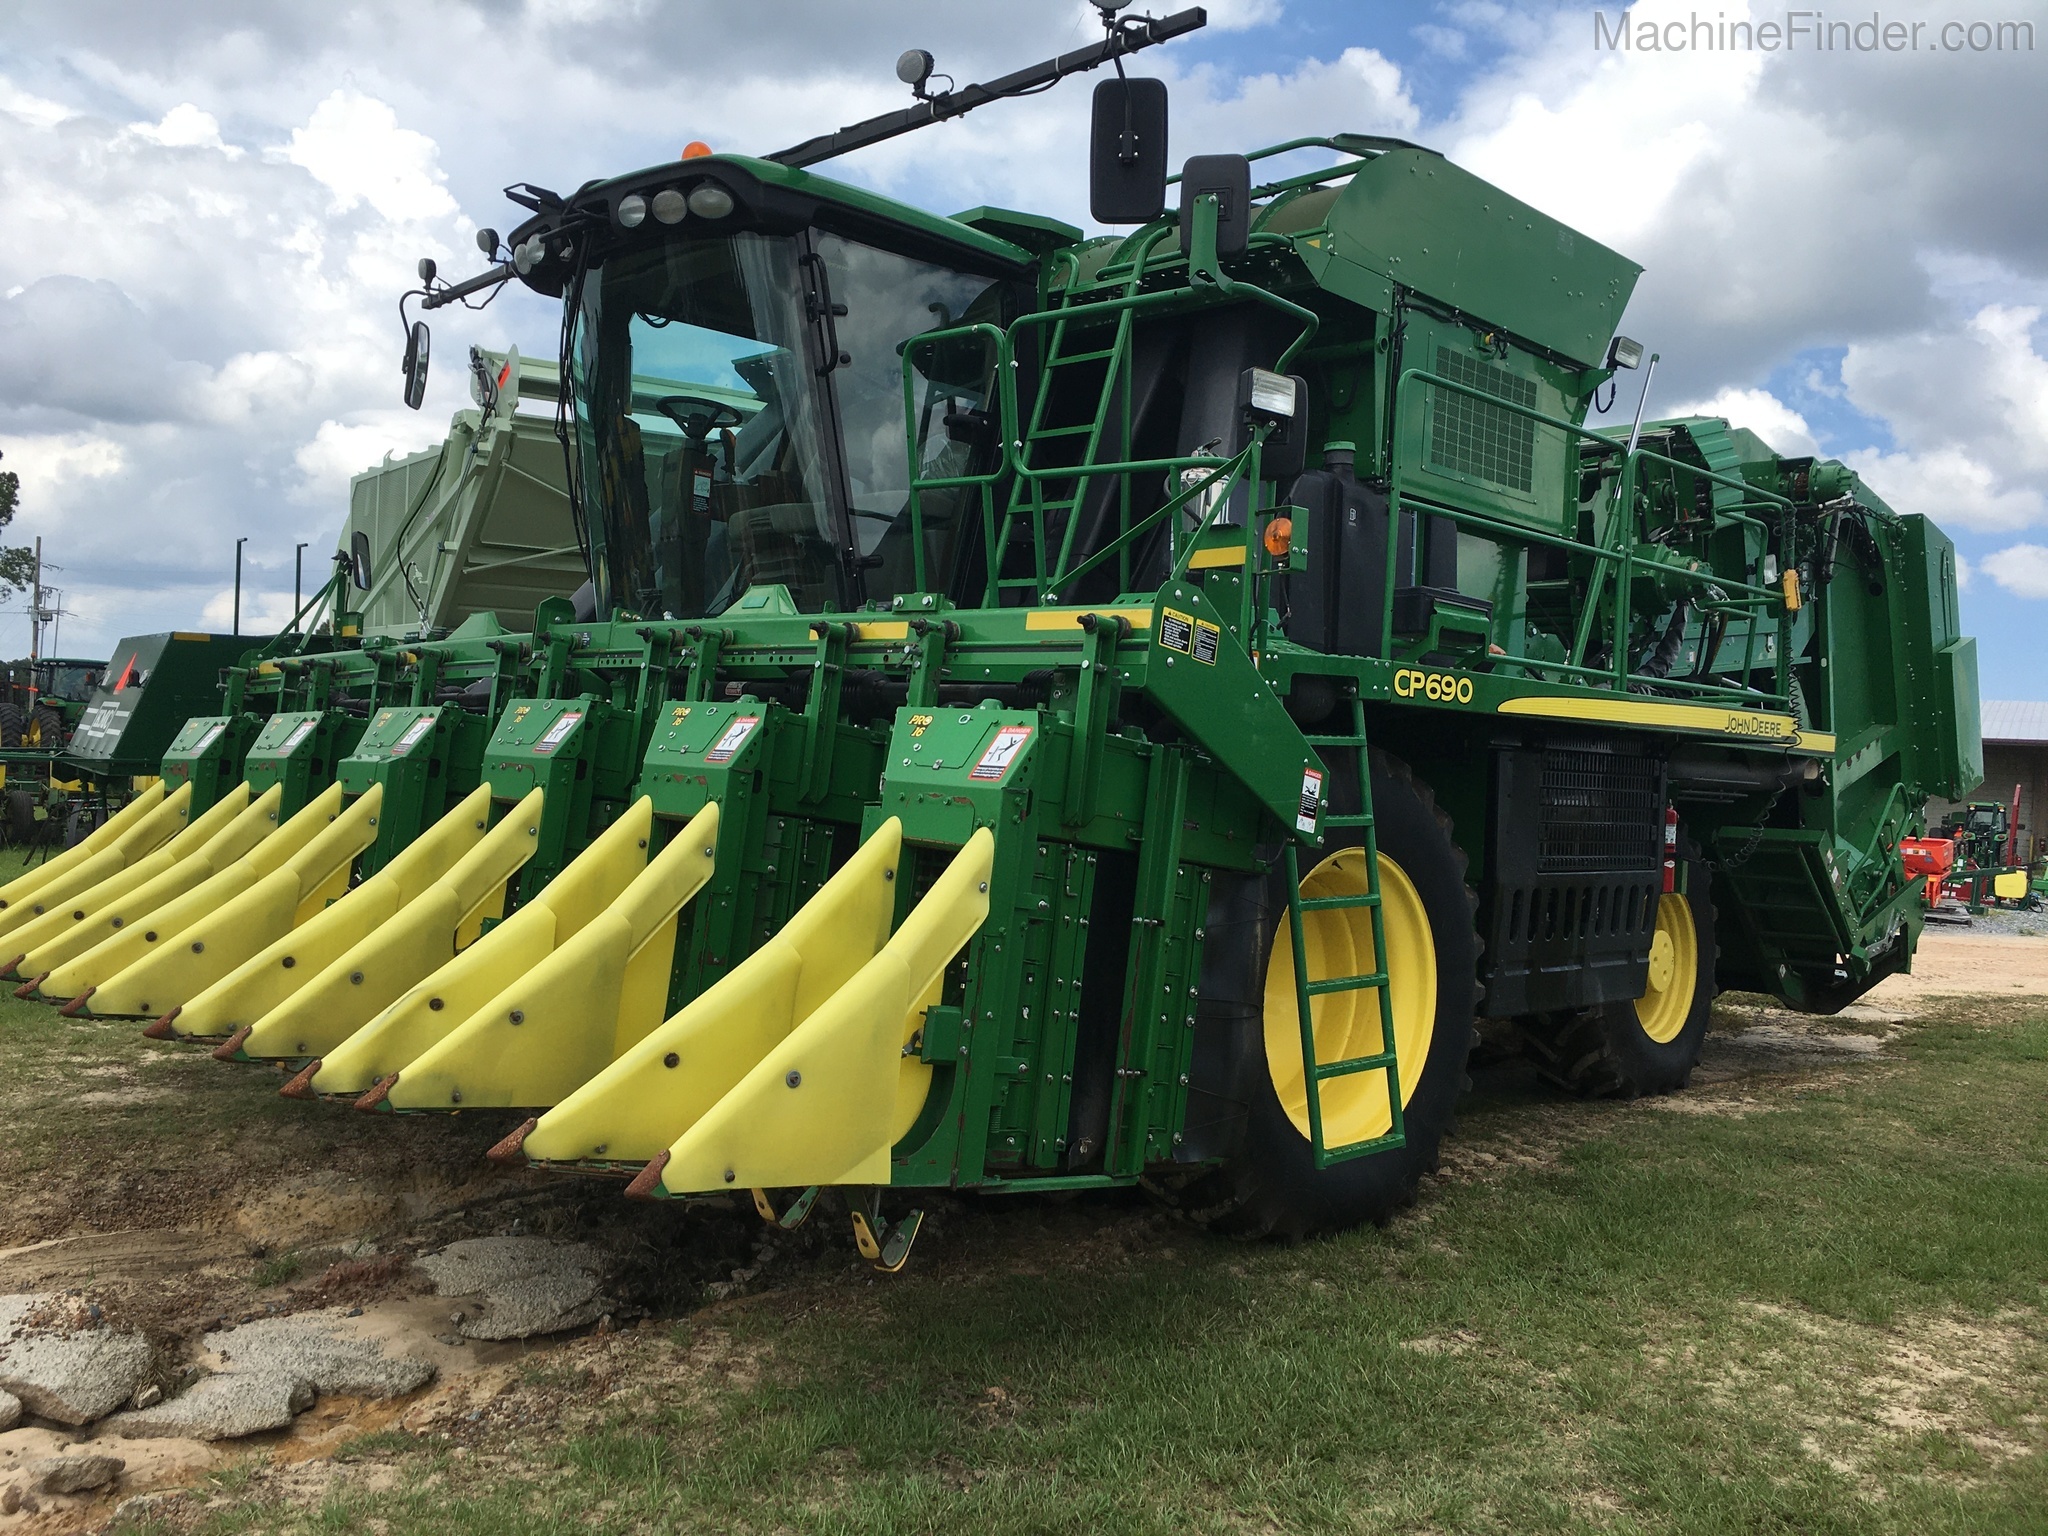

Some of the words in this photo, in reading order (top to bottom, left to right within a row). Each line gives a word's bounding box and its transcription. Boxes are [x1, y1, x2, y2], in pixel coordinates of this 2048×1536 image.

[1393, 669, 1473, 704] CP690
[672, 707, 692, 716] PRO
[672, 717, 684, 727] 16
[909, 715, 934, 726] PRO
[1724, 714, 1750, 735] JOHN
[1751, 717, 1781, 738] DEERE
[910, 727, 926, 738] 16
